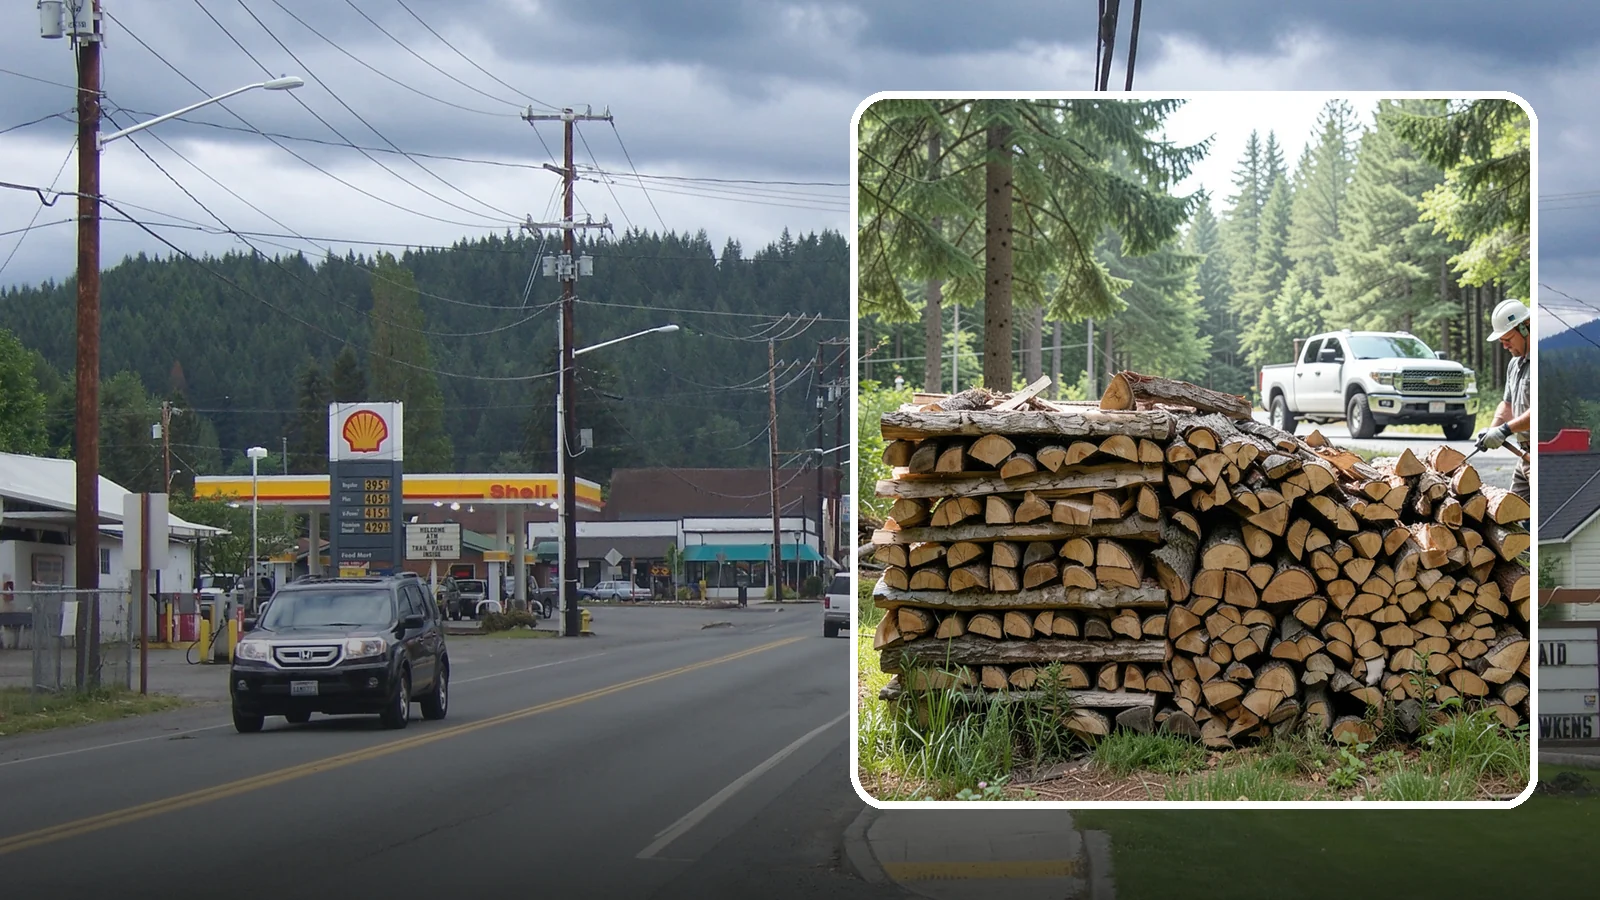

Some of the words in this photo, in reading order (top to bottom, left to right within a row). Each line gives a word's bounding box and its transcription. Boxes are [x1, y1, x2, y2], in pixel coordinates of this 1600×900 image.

[365, 480, 383, 490] 395
[490, 484, 547, 499] Shell
[365, 494, 383, 504] 405
[365, 508, 383, 518] 415
[365, 522, 383, 533] 429
[1539, 643, 1567, 665] AID
